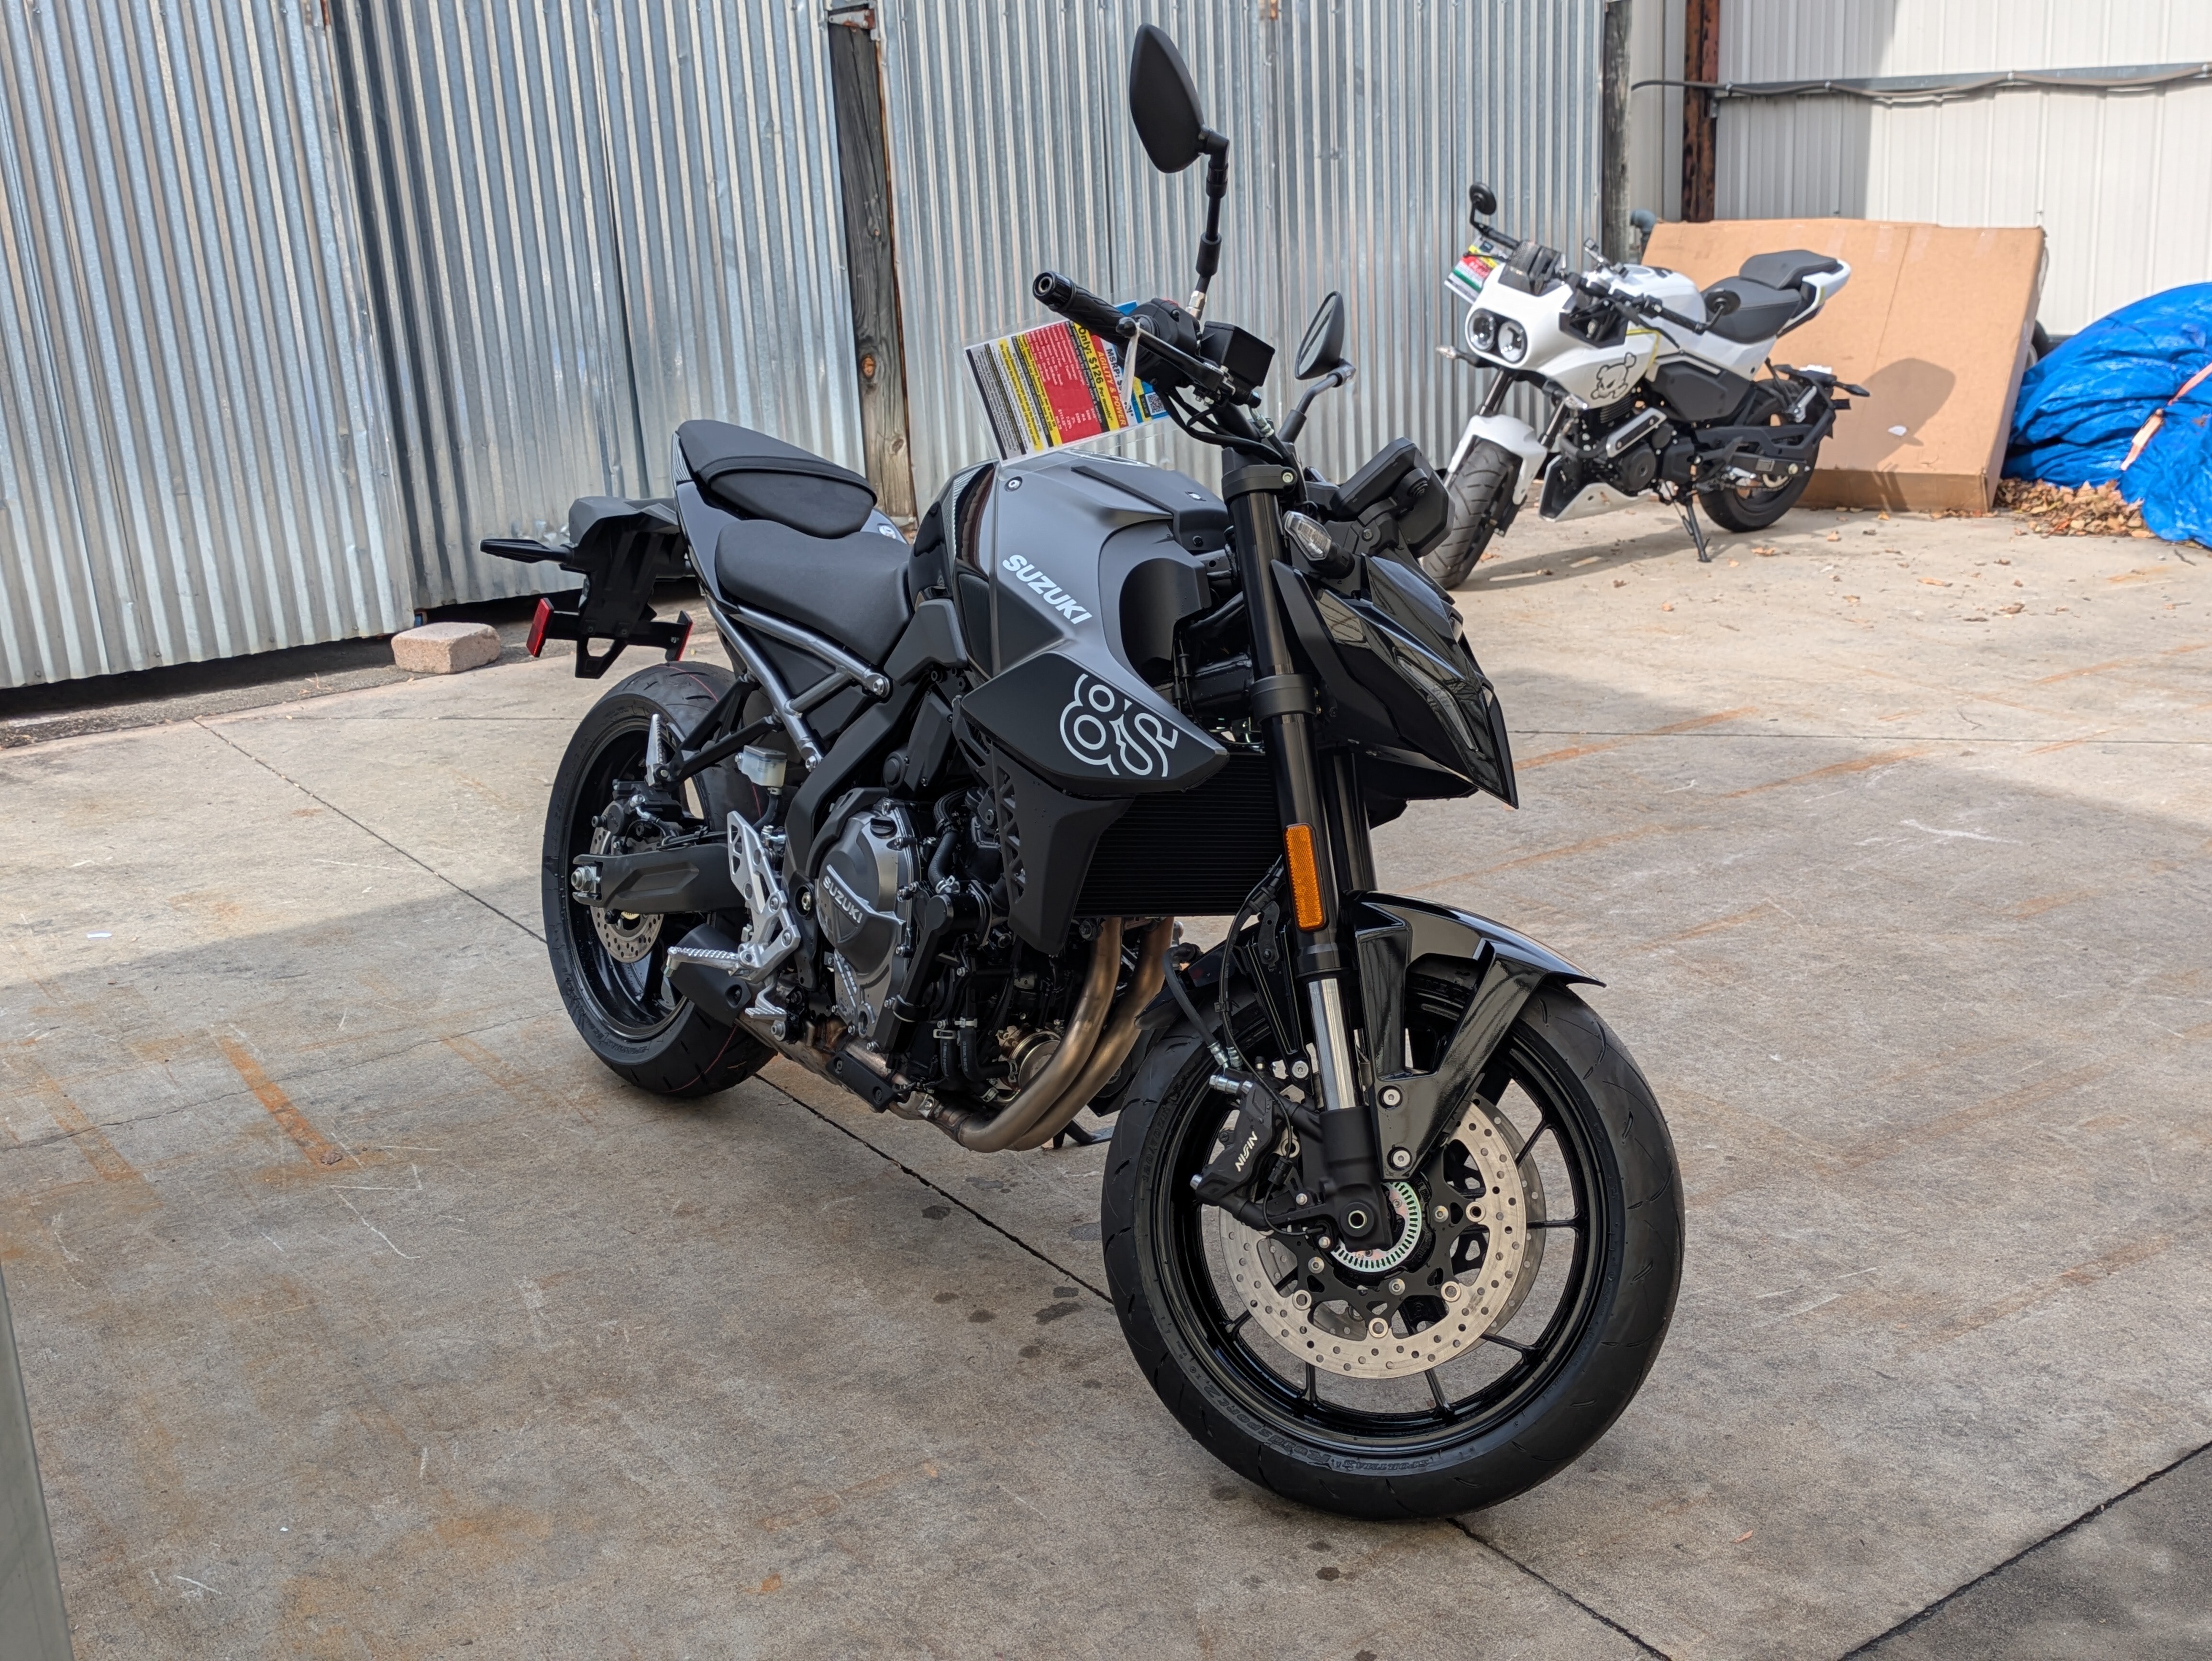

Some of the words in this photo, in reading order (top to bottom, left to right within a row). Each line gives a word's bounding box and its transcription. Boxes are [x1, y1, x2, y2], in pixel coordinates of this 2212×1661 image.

[1077, 326, 1093, 355] Only:
[1088, 356, 1104, 385] $126
[1106, 347, 1121, 378] MSRP:
[1096, 350, 1114, 386] AGILITY
[1111, 394, 1127, 426] POWER
[1002, 554, 1093, 625] SUZUKI
[822, 875, 863, 924] SUZUKI
[1234, 1130, 1258, 1172] NISSIN
